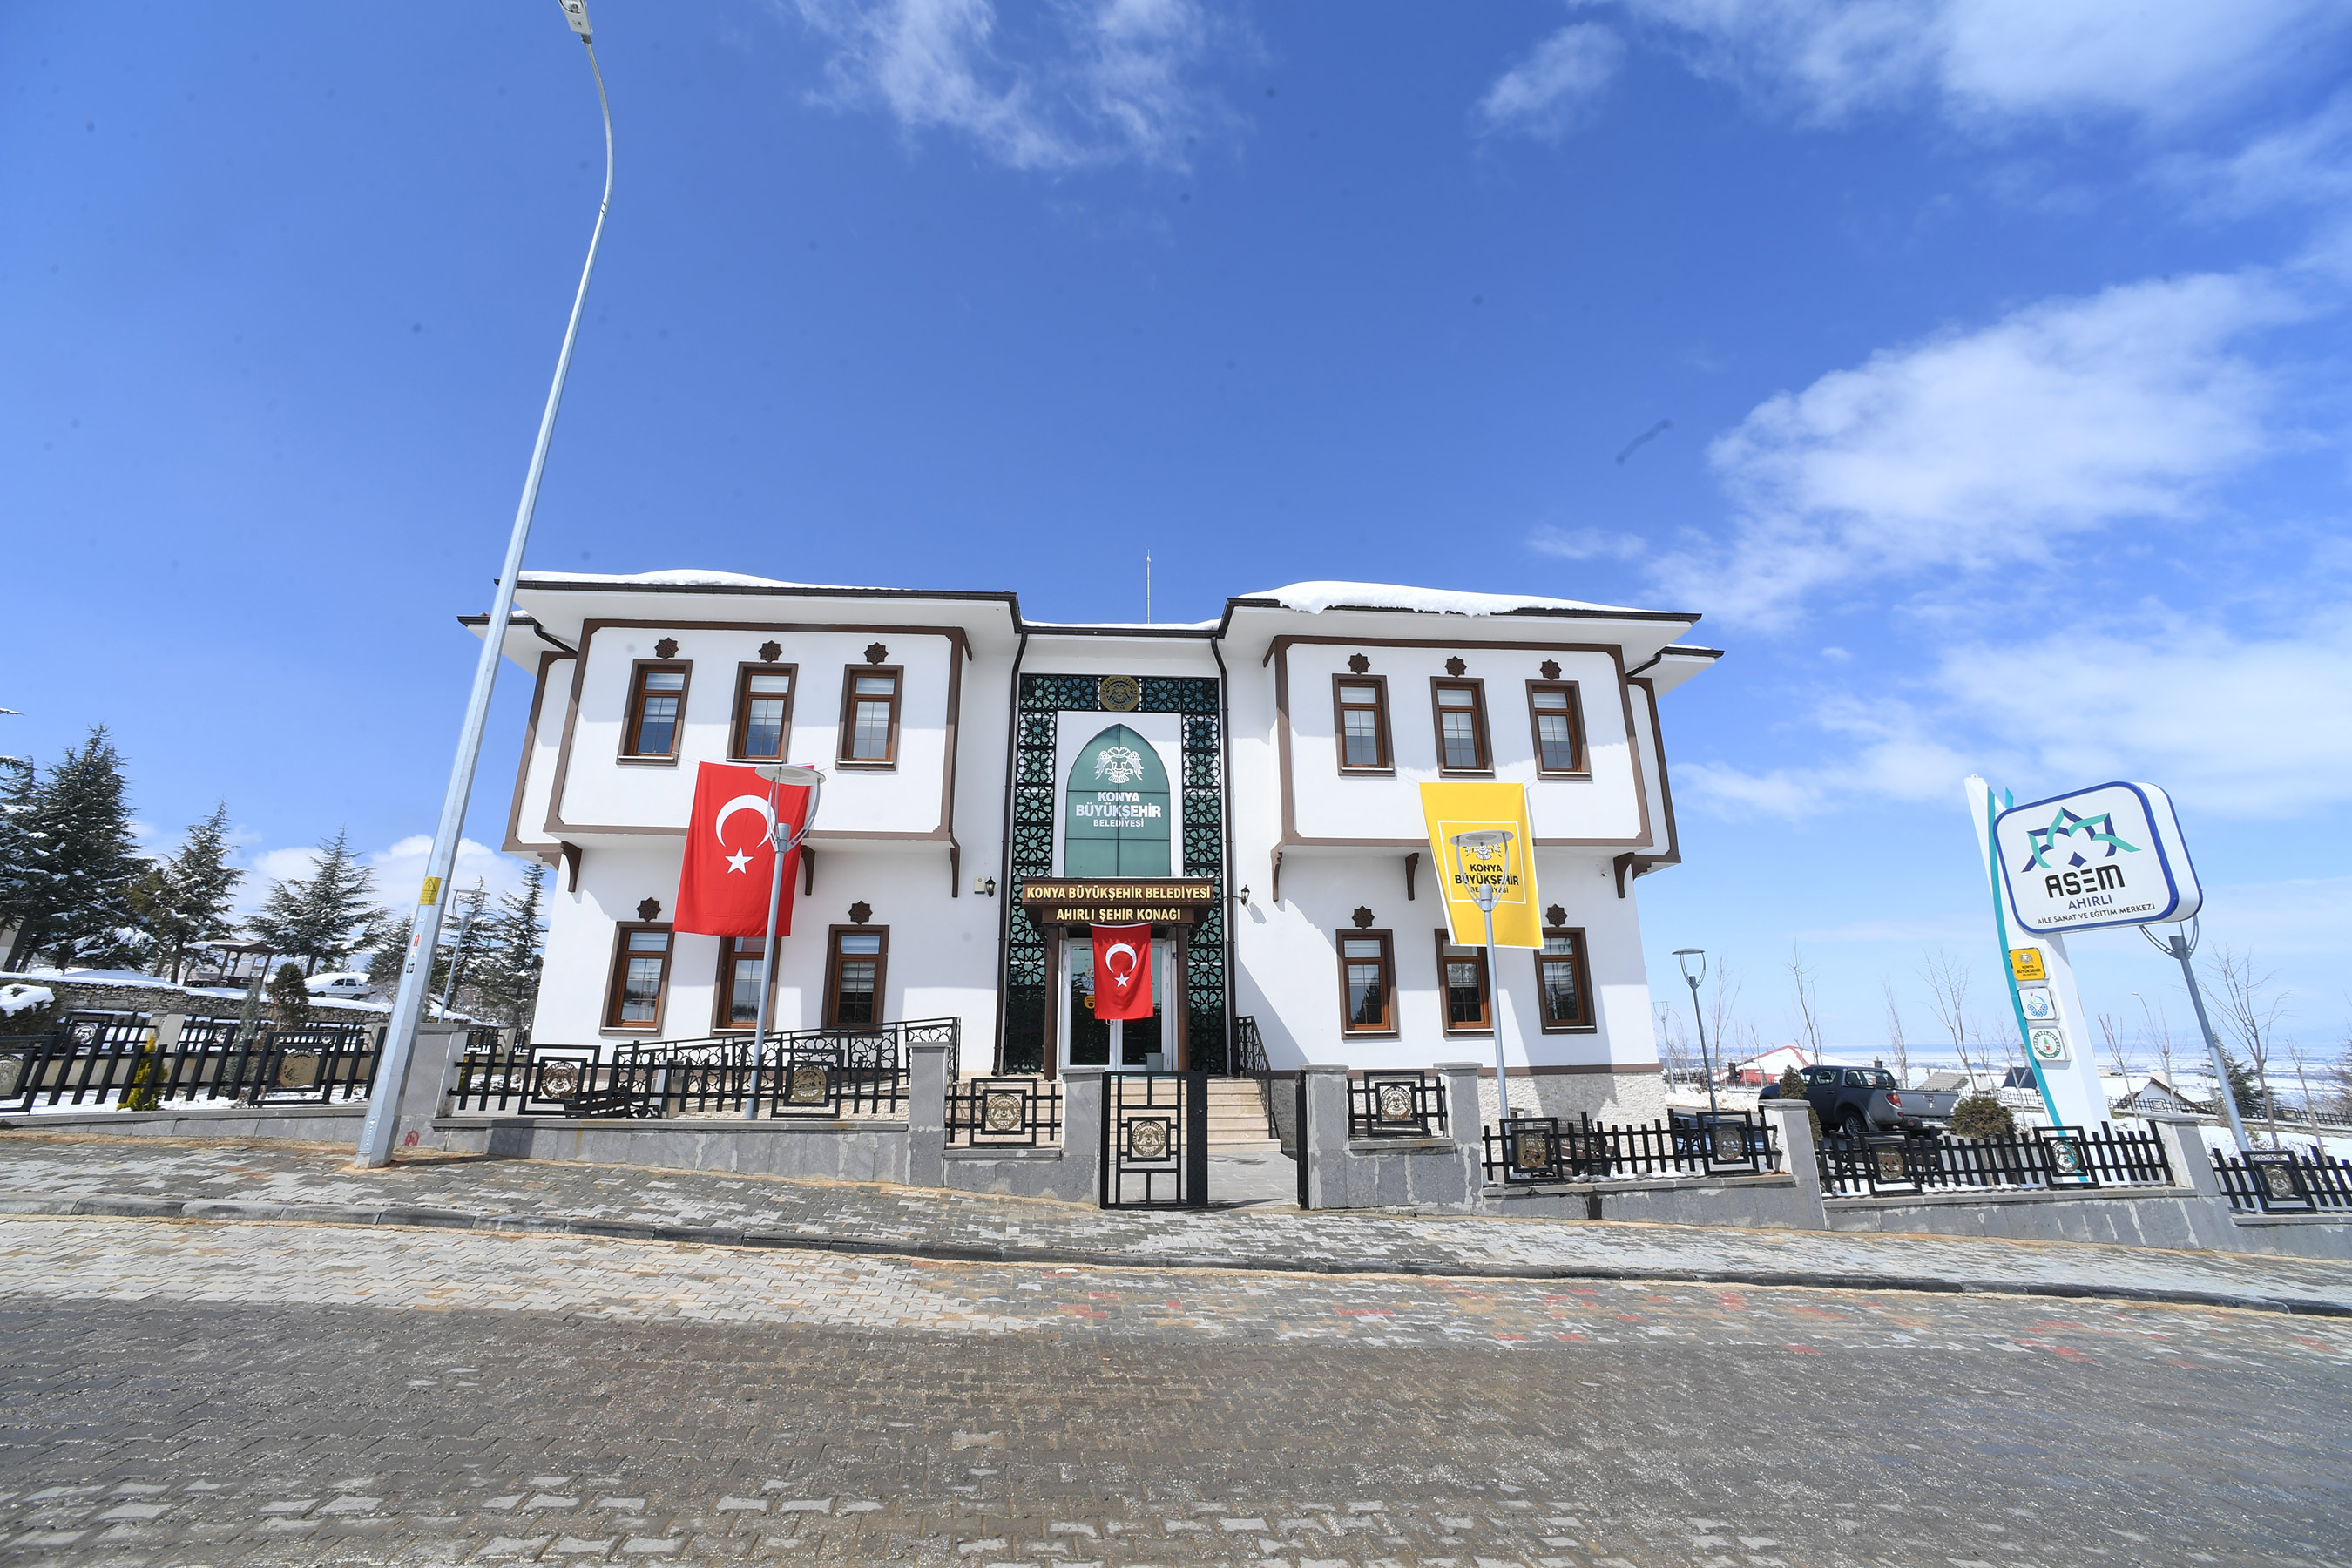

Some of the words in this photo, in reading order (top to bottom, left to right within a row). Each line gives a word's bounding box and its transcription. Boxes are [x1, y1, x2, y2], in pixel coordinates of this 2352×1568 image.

[1098, 791, 1140, 802] KONYA
[1076, 801, 1161, 819] BÜYÜKŞEHİR
[1093, 817, 1144, 827] BELEDİYESİ
[2044, 864, 2126, 898] ASEM
[1027, 887, 1065, 898] KONYA
[1069, 885, 1142, 901] BÜYÜKŞEHİR
[1146, 885, 1211, 898] BELEDİYESİ
[2068, 894, 2113, 909] AHIRLI
[1056, 909, 1095, 920] AHIRLI
[1098, 908, 1133, 922] ŞEHİR
[1136, 907, 1181, 920] KONAĞI
[2053, 914, 2077, 923] SANAT
[2090, 909, 2118, 918] EĞİTİM
[2119, 902, 2156, 914] MERKEZİ
